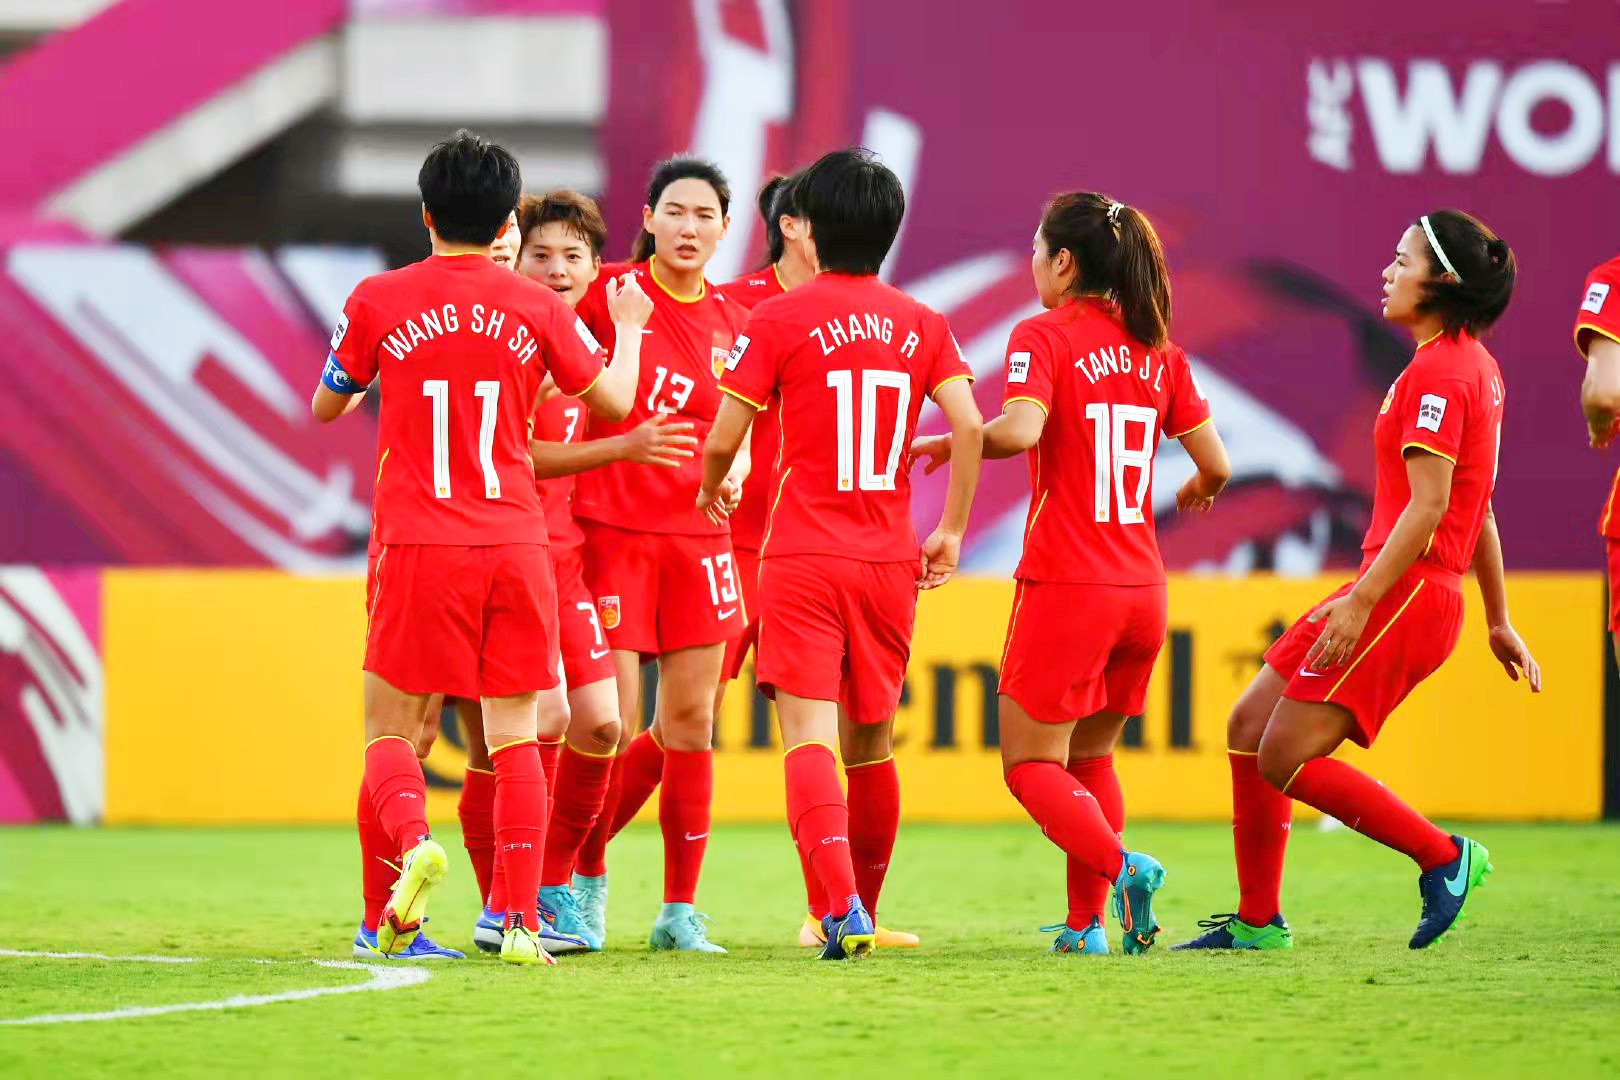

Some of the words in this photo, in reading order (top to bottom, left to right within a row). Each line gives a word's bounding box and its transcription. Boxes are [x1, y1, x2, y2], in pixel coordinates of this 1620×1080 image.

[1355, 57, 1620, 176] WO
[382, 304, 459, 361] WANG
[471, 304, 505, 340] SH
[508, 324, 538, 365] SH
[809, 313, 893, 356] ZHANG
[901, 331, 919, 359] R
[647, 366, 695, 417] 13
[1074, 345, 1132, 384] TANG
[1139, 355, 1150, 380] J
[422, 379, 501, 499] 11
[564, 407, 579, 444] 7
[826, 368, 911, 491] 10
[1085, 402, 1158, 525] 18
[701, 552, 738, 606] 13
[576, 602, 602, 645] 7
